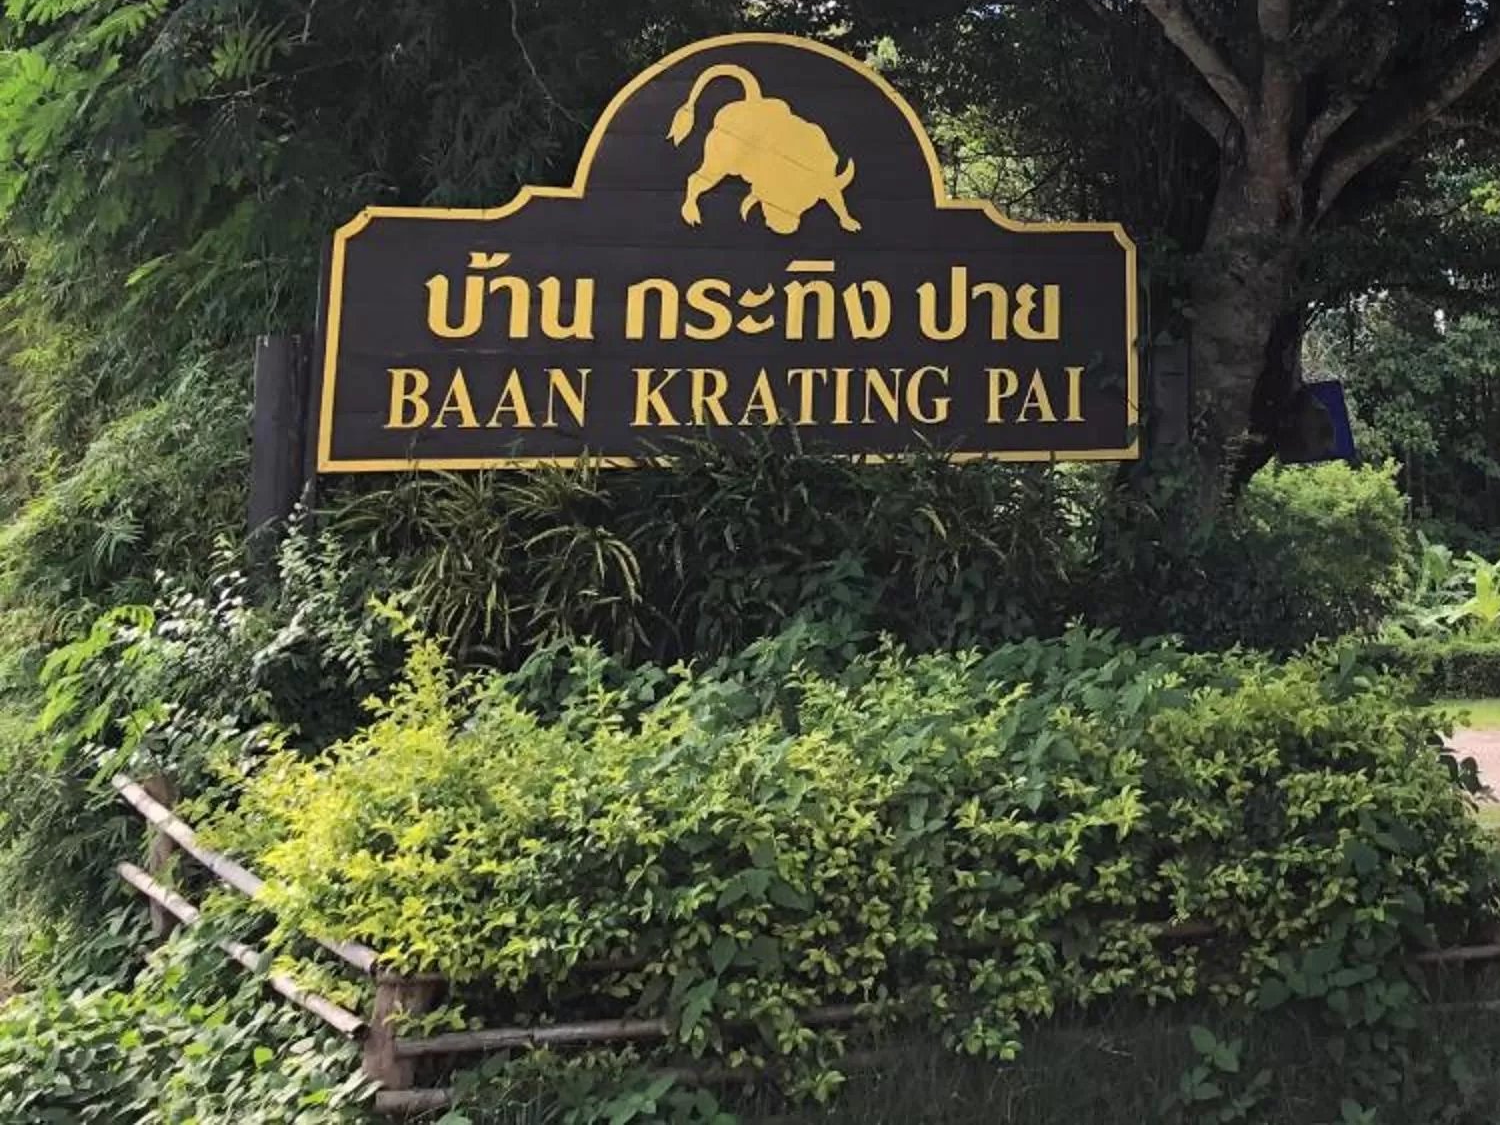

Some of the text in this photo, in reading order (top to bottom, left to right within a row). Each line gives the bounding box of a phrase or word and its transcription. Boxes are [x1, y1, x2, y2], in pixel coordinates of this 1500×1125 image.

[425, 251, 1061, 341] บ้าน กระทิง ปาย
[383, 365, 1087, 430] BAAN KRATING PAI
